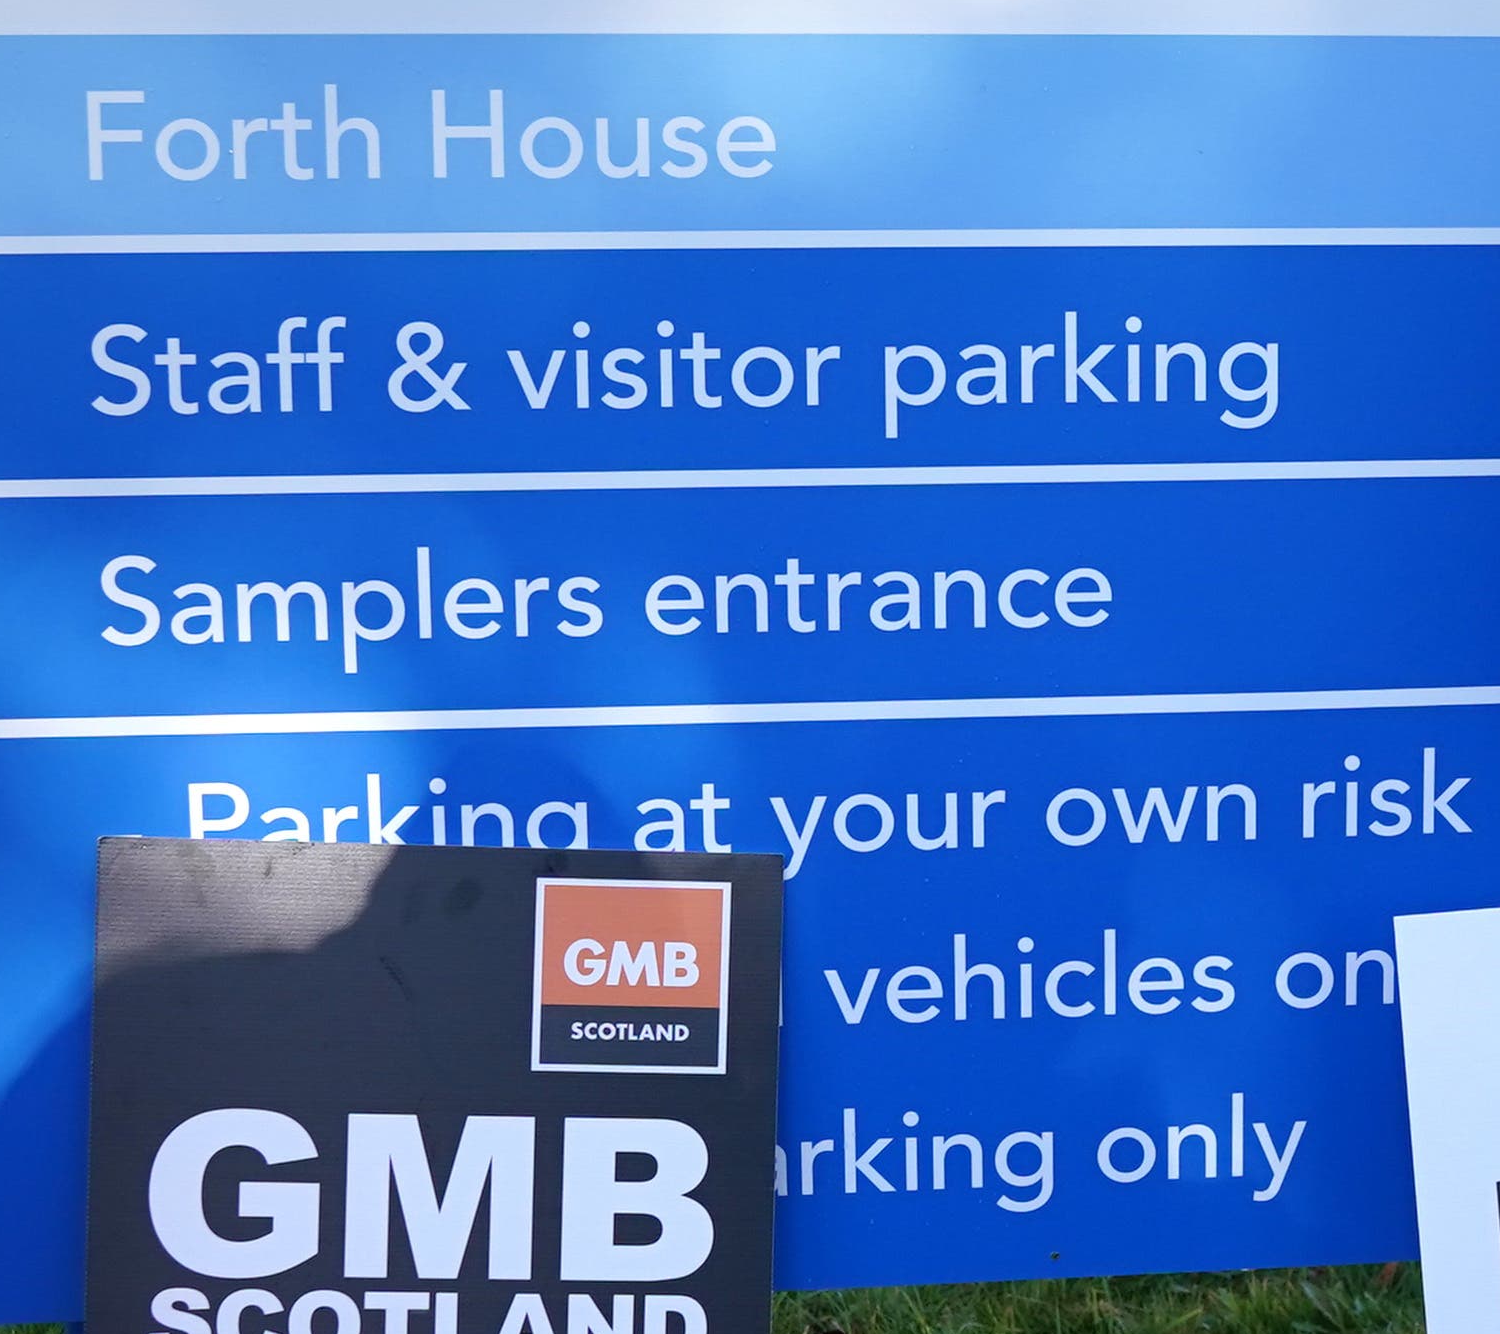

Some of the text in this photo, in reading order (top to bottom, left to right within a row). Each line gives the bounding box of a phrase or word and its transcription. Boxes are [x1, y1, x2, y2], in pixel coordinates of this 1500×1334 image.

[87, 85, 777, 182] Forth House
[91, 312, 1283, 438] Staff & visitor parking
[100, 548, 1113, 673] Samplers entrance
[187, 749, 1470, 880] Parking at your own risk
[563, 938, 700, 988] GMB
[824, 932, 1236, 1026] vehicles
[1275, 949, 1395, 1010] on
[571, 1021, 690, 1043] SCOTLAND
[148, 1107, 715, 1280] GMB
[1097, 1093, 1305, 1201] only
